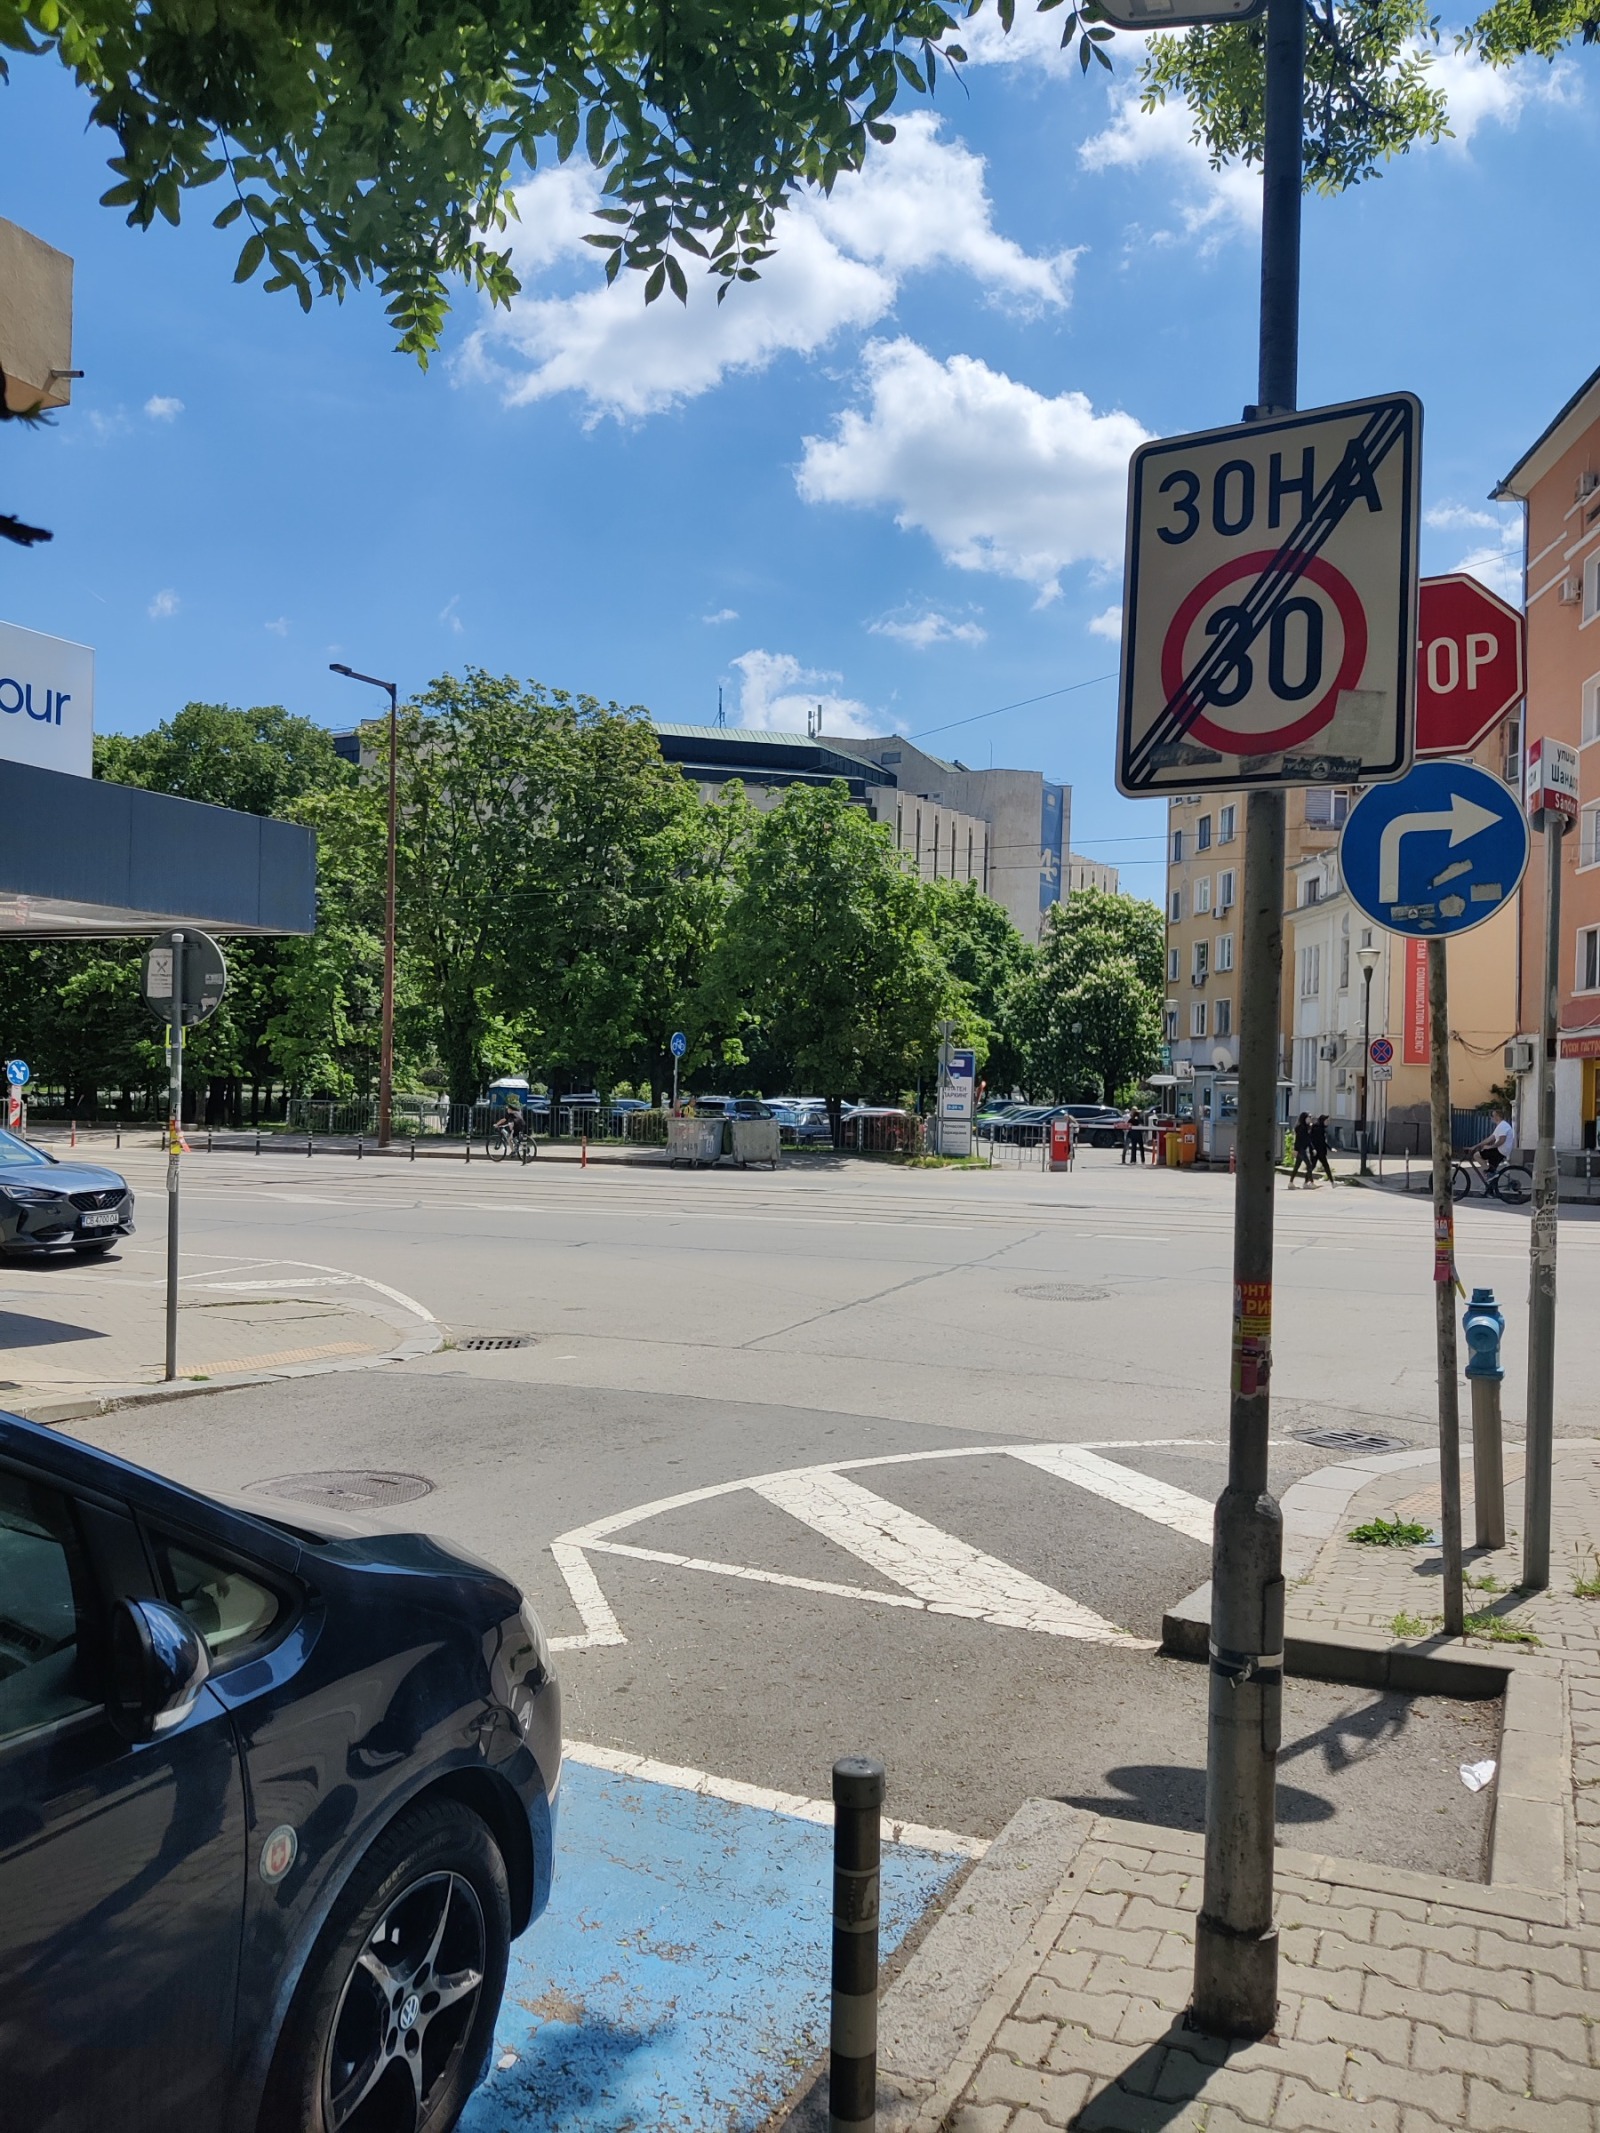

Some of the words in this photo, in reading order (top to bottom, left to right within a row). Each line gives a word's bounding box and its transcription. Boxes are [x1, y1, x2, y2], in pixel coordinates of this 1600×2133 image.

[1203, 596, 1323, 707] 30
[1416, 632, 1498, 694] OP
[1415, 966, 1426, 1025] COMMUNICATION
[1414, 1026, 1424, 1055] AGENCY
